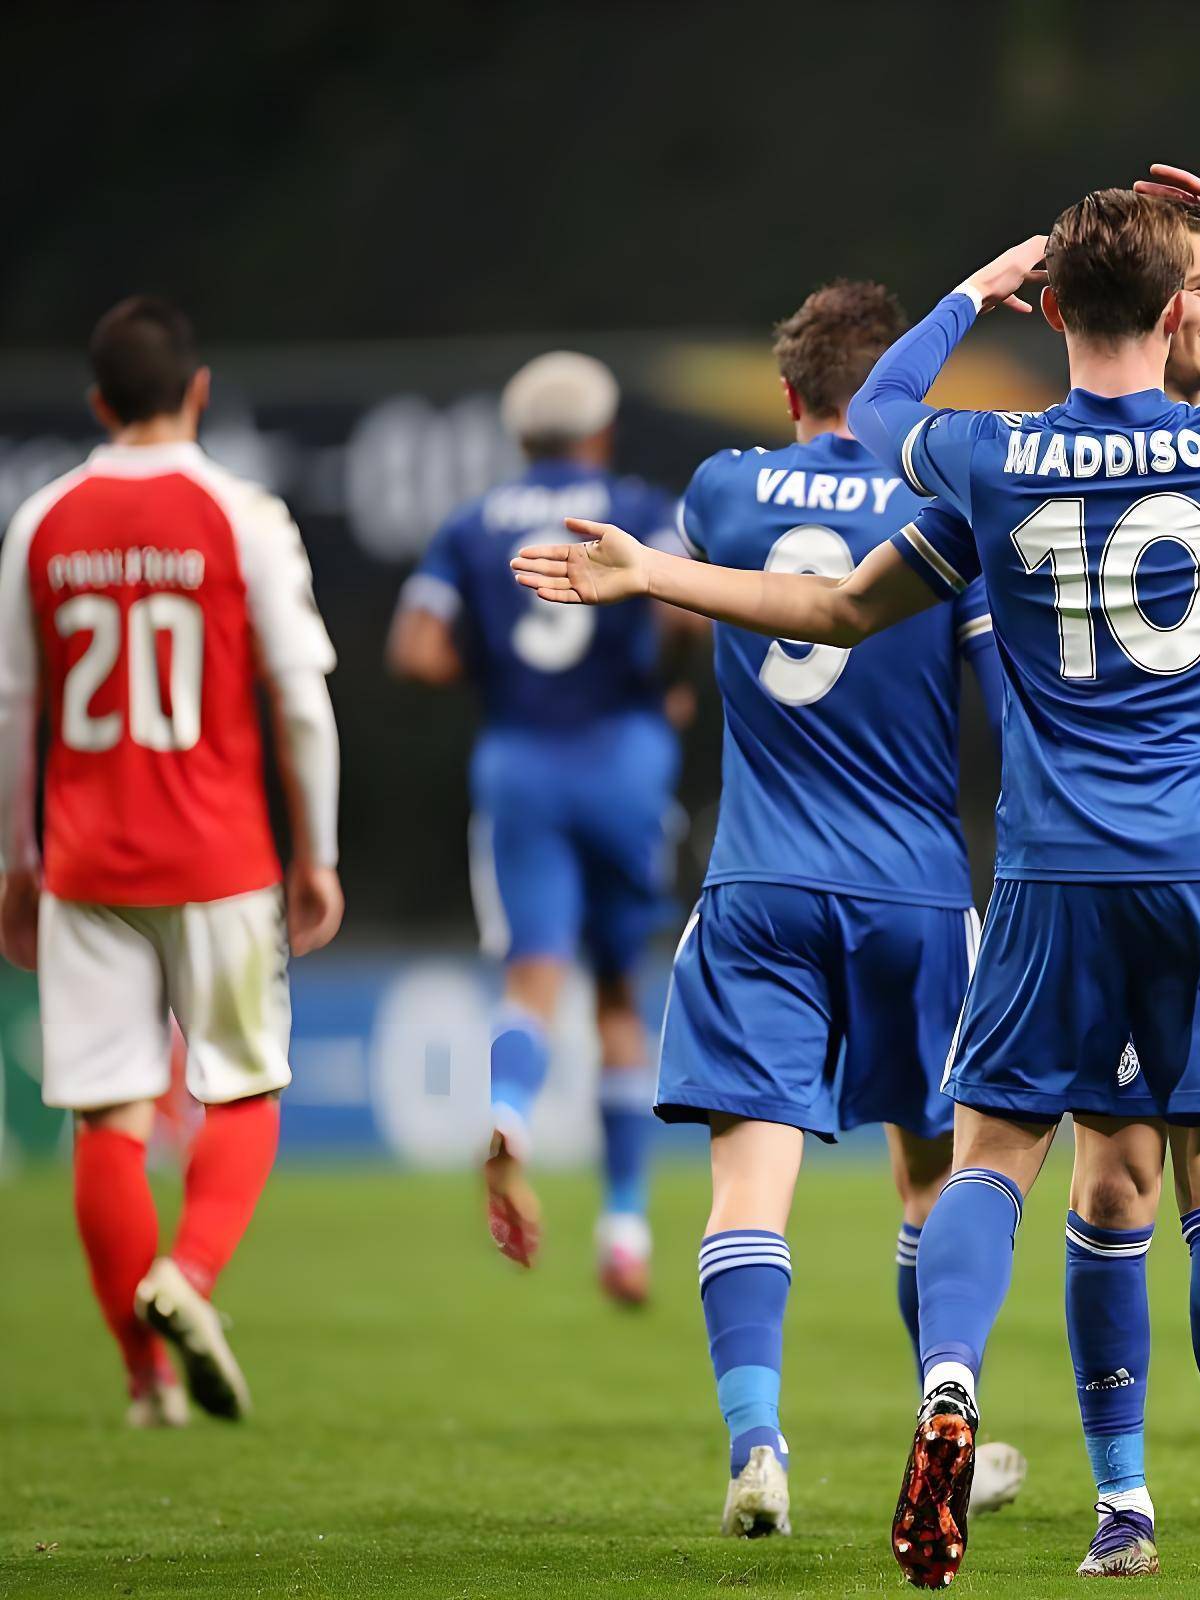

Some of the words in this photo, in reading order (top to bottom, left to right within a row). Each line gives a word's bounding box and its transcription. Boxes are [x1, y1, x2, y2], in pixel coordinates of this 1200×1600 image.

[756, 467, 903, 514] VARDY
[53, 592, 206, 753] 20
[758, 523, 856, 708] 9
